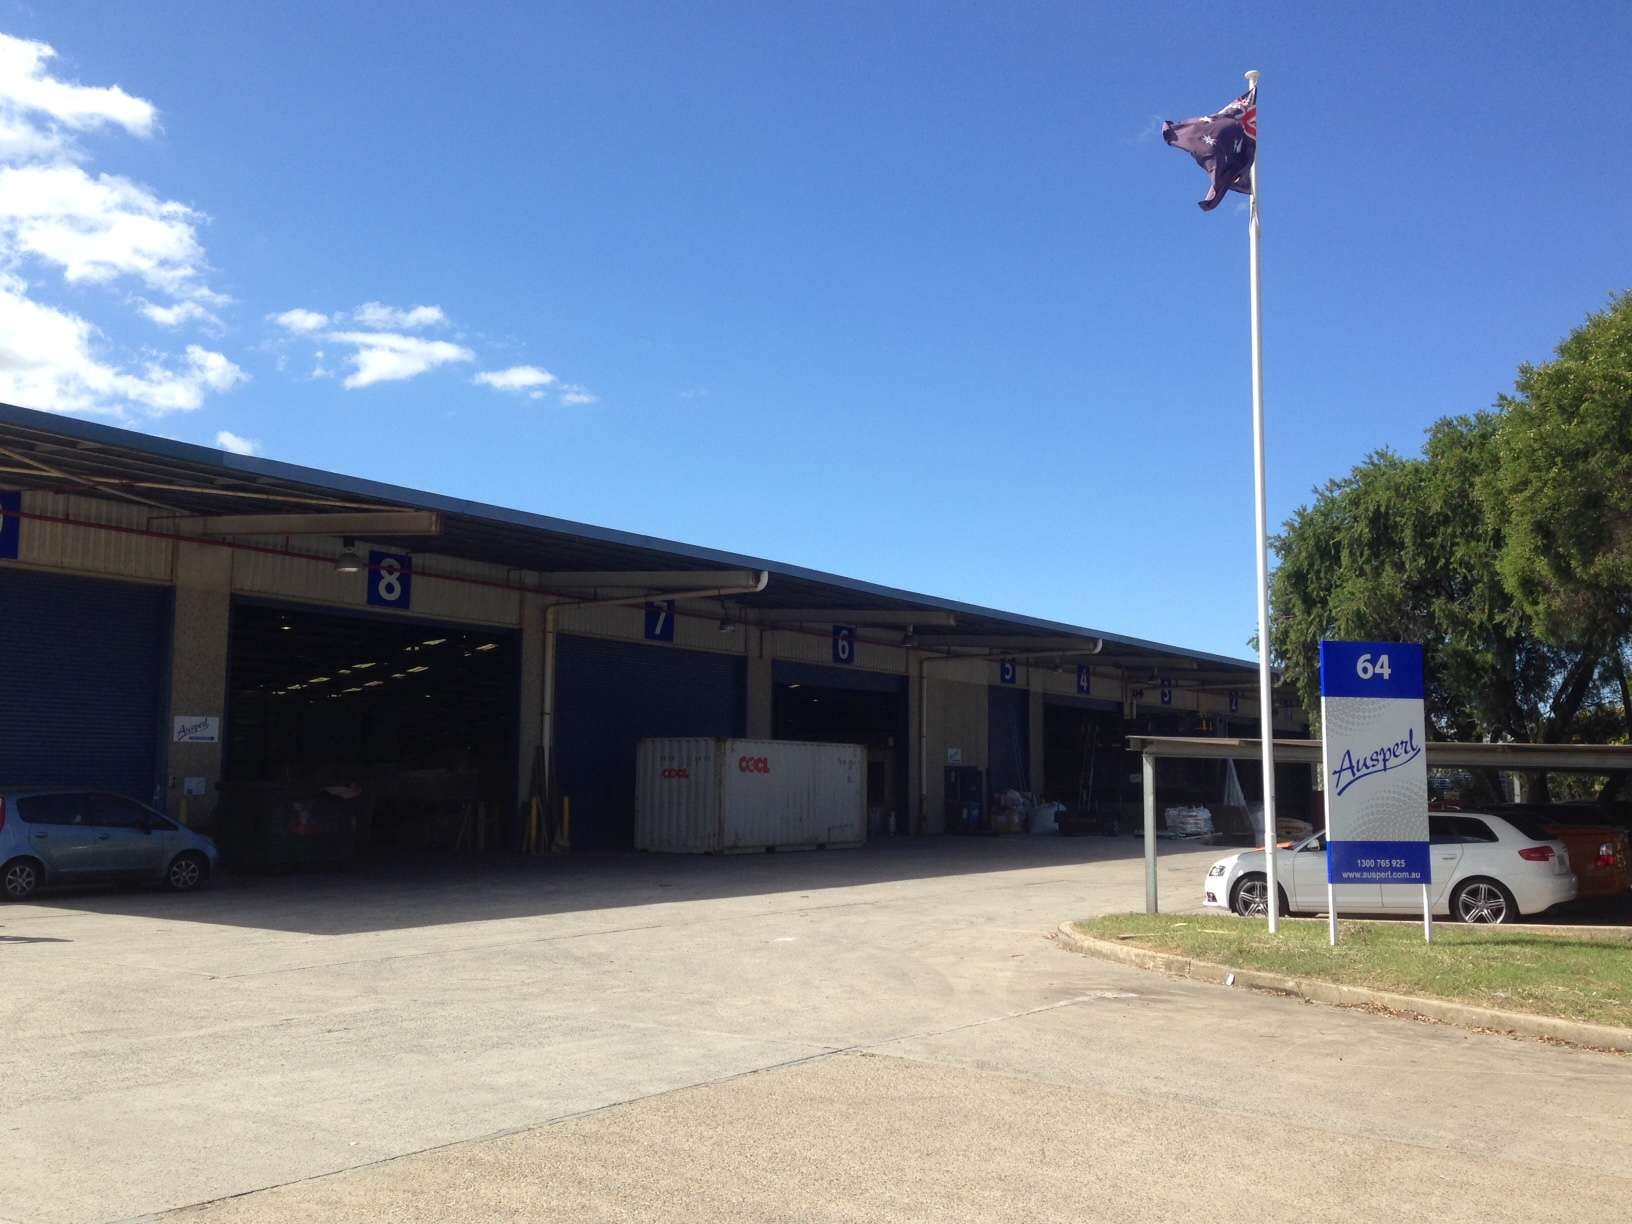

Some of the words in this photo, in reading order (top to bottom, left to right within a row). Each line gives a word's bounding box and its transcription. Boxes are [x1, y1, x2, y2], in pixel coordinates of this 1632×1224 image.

[378, 558, 402, 601] 8
[653, 601, 668, 635] 7
[838, 629, 849, 660] 6
[1079, 667, 1088, 691] 4
[1356, 653, 1392, 680] 64
[1332, 728, 1420, 795] Ausperl
[1357, 859, 1375, 868] 1300
[1376, 859, 1391, 868] 765
[1391, 859, 1406, 868] 925
